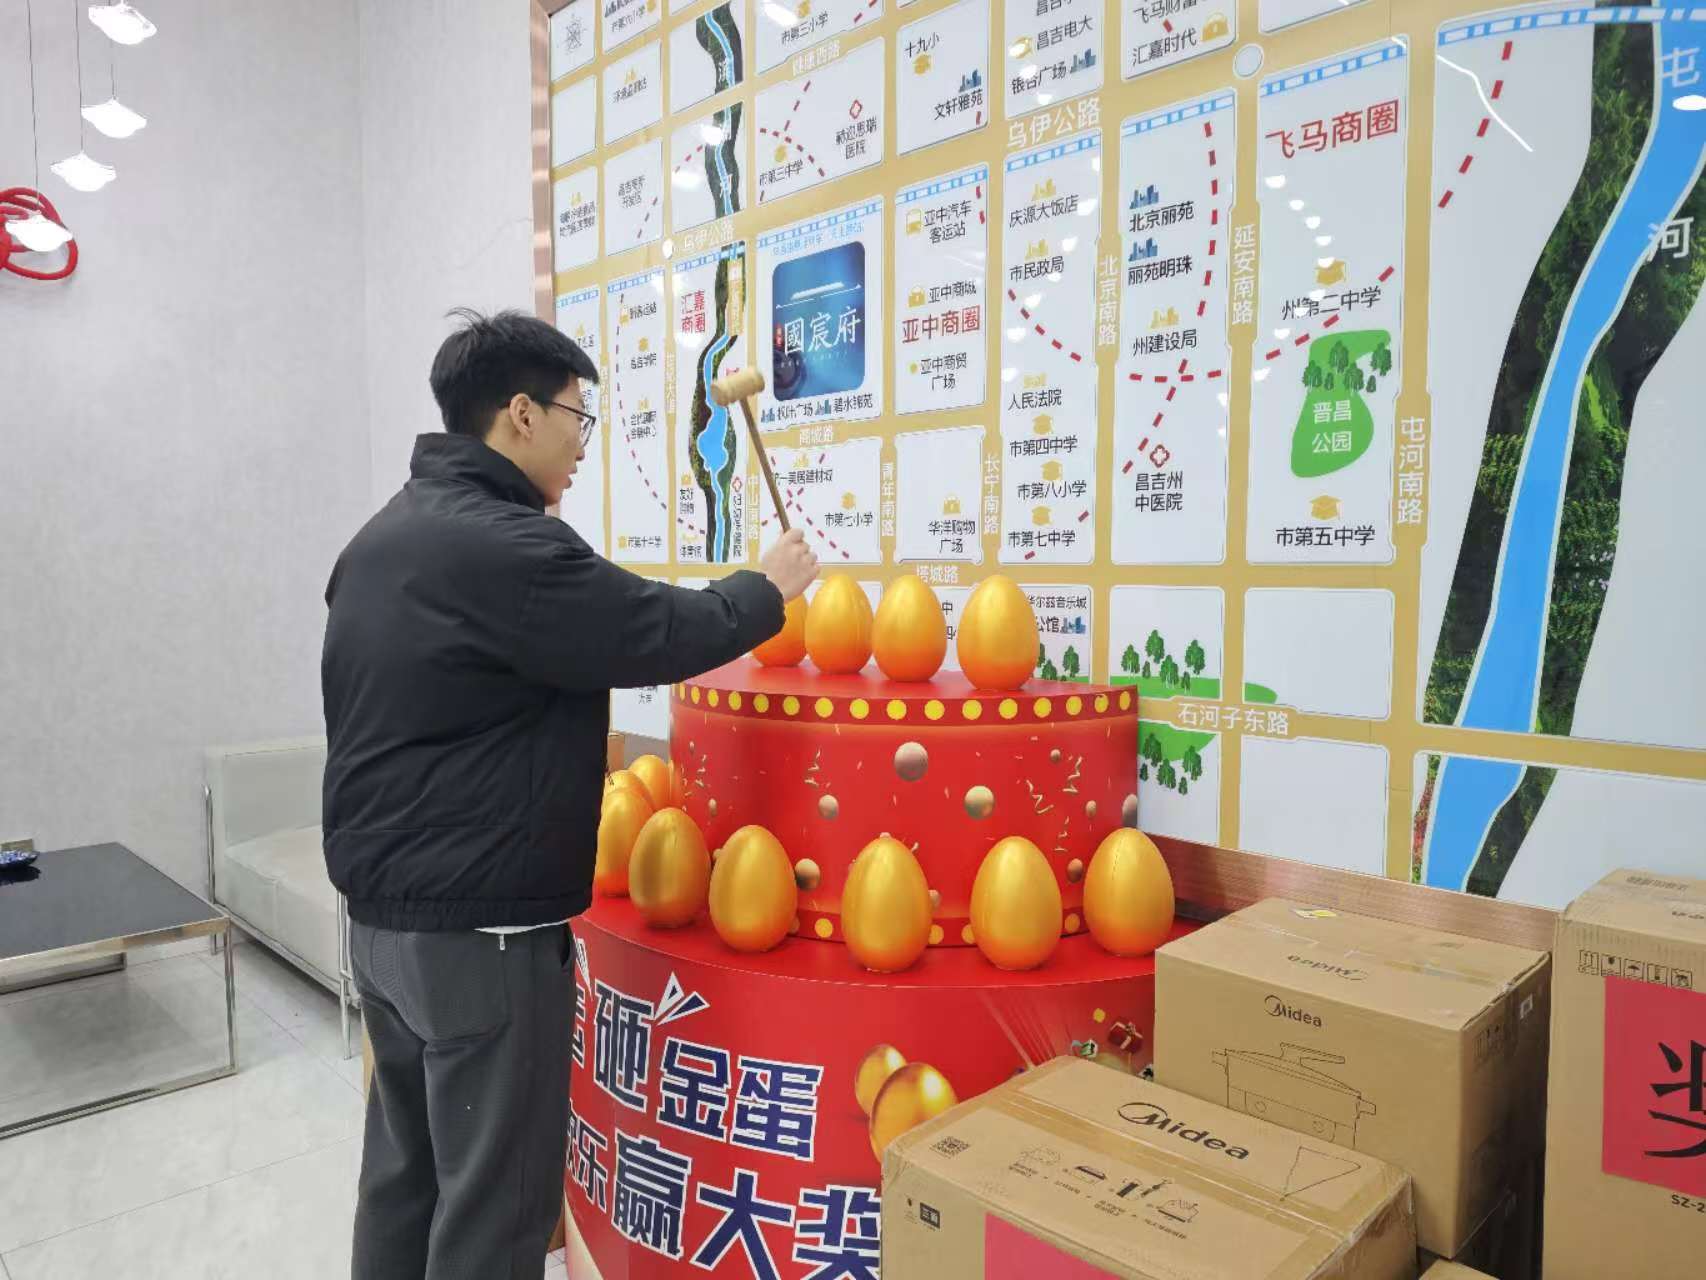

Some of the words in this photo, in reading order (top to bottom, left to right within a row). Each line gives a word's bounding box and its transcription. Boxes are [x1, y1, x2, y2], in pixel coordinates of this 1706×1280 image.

[904, 32, 940, 58] 十九小
[1036, 15, 1093, 50] 昌吉电大
[1133, 28, 1197, 67] 汇嘉时代
[1011, 61, 1067, 94] 银谷广场
[1661, 47, 1700, 88] 屯
[934, 89, 983, 120] 文轩雅苑
[1007, 97, 1101, 148] 乌伊公路
[1265, 99, 1399, 159] 飞马商圈
[845, 139, 867, 159] 医院
[759, 160, 804, 186] 市第三中学
[924, 200, 972, 227] 亚中汽车
[1009, 195, 1079, 228] 庆源大饭店
[1129, 201, 1194, 232] 北京丽苑
[929, 221, 966, 244] 客运站
[1647, 216, 1694, 262] 河
[1009, 256, 1065, 283] 市民政局
[1128, 255, 1193, 286] 丽苑明珠
[1231, 223, 1256, 325] 延安南路
[928, 280, 977, 304] 亚中商城
[1099, 254, 1118, 346] 北京南路
[1282, 285, 1381, 320] 州第二中学
[784, 306, 861, 357] 國宸府
[902, 305, 980, 343] 亚中商圈
[1133, 328, 1197, 356] 州建设局
[921, 352, 967, 375] 亚中商贸
[931, 373, 956, 391] 广场
[1008, 388, 1062, 411] 人民法院
[1312, 400, 1352, 424] 晋昌
[1010, 435, 1078, 458] 市第四中学
[1312, 431, 1352, 454] 公园
[1135, 470, 1184, 492] 昌吉州
[1397, 416, 1425, 524] 屯河南路
[881, 462, 895, 537] 青年南路
[984, 453, 1000, 536] 长宁南路
[1017, 480, 1087, 501] 市第八小学
[1135, 493, 1184, 512] 中医院
[825, 512, 873, 528] 市第七小学
[928, 519, 976, 536] 华洋购物
[939, 538, 963, 553] 广场
[1008, 530, 1076, 548] 市第七中学
[1276, 525, 1376, 547] 市第五中学
[1178, 703, 1289, 736] 石河子东路
[1264, 994, 1323, 1029] Midea
[572, 977, 824, 1162] 砸金蛋
[1117, 1102, 1249, 1160] Midea
